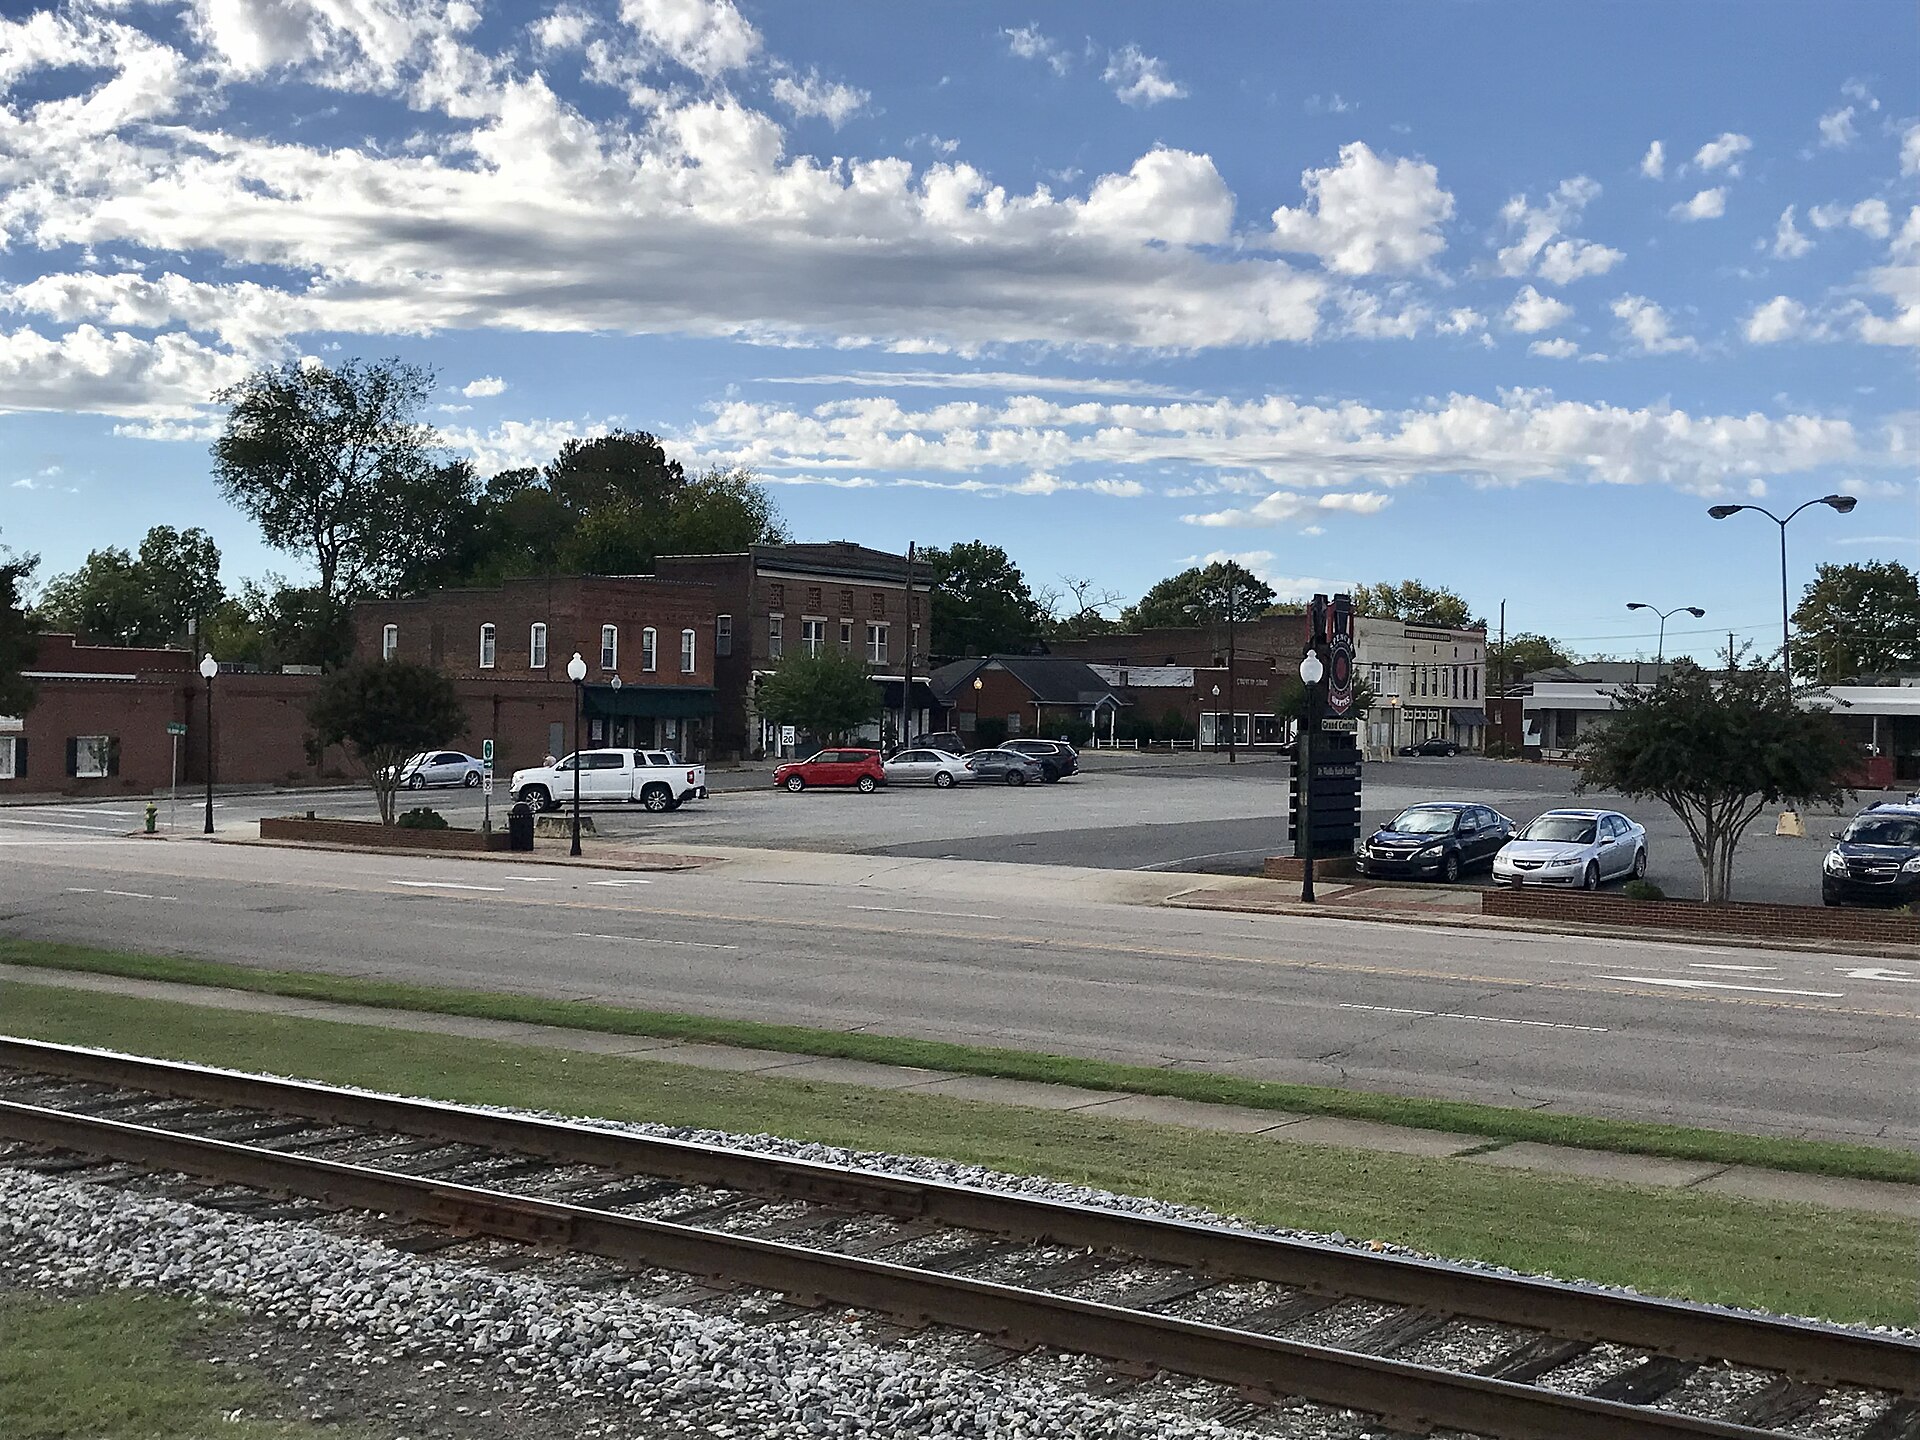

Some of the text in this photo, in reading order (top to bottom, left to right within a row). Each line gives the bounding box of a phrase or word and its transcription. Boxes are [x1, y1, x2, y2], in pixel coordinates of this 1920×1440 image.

[1322, 720, 1356, 730] Grand Central
[783, 735, 793, 743] 20
